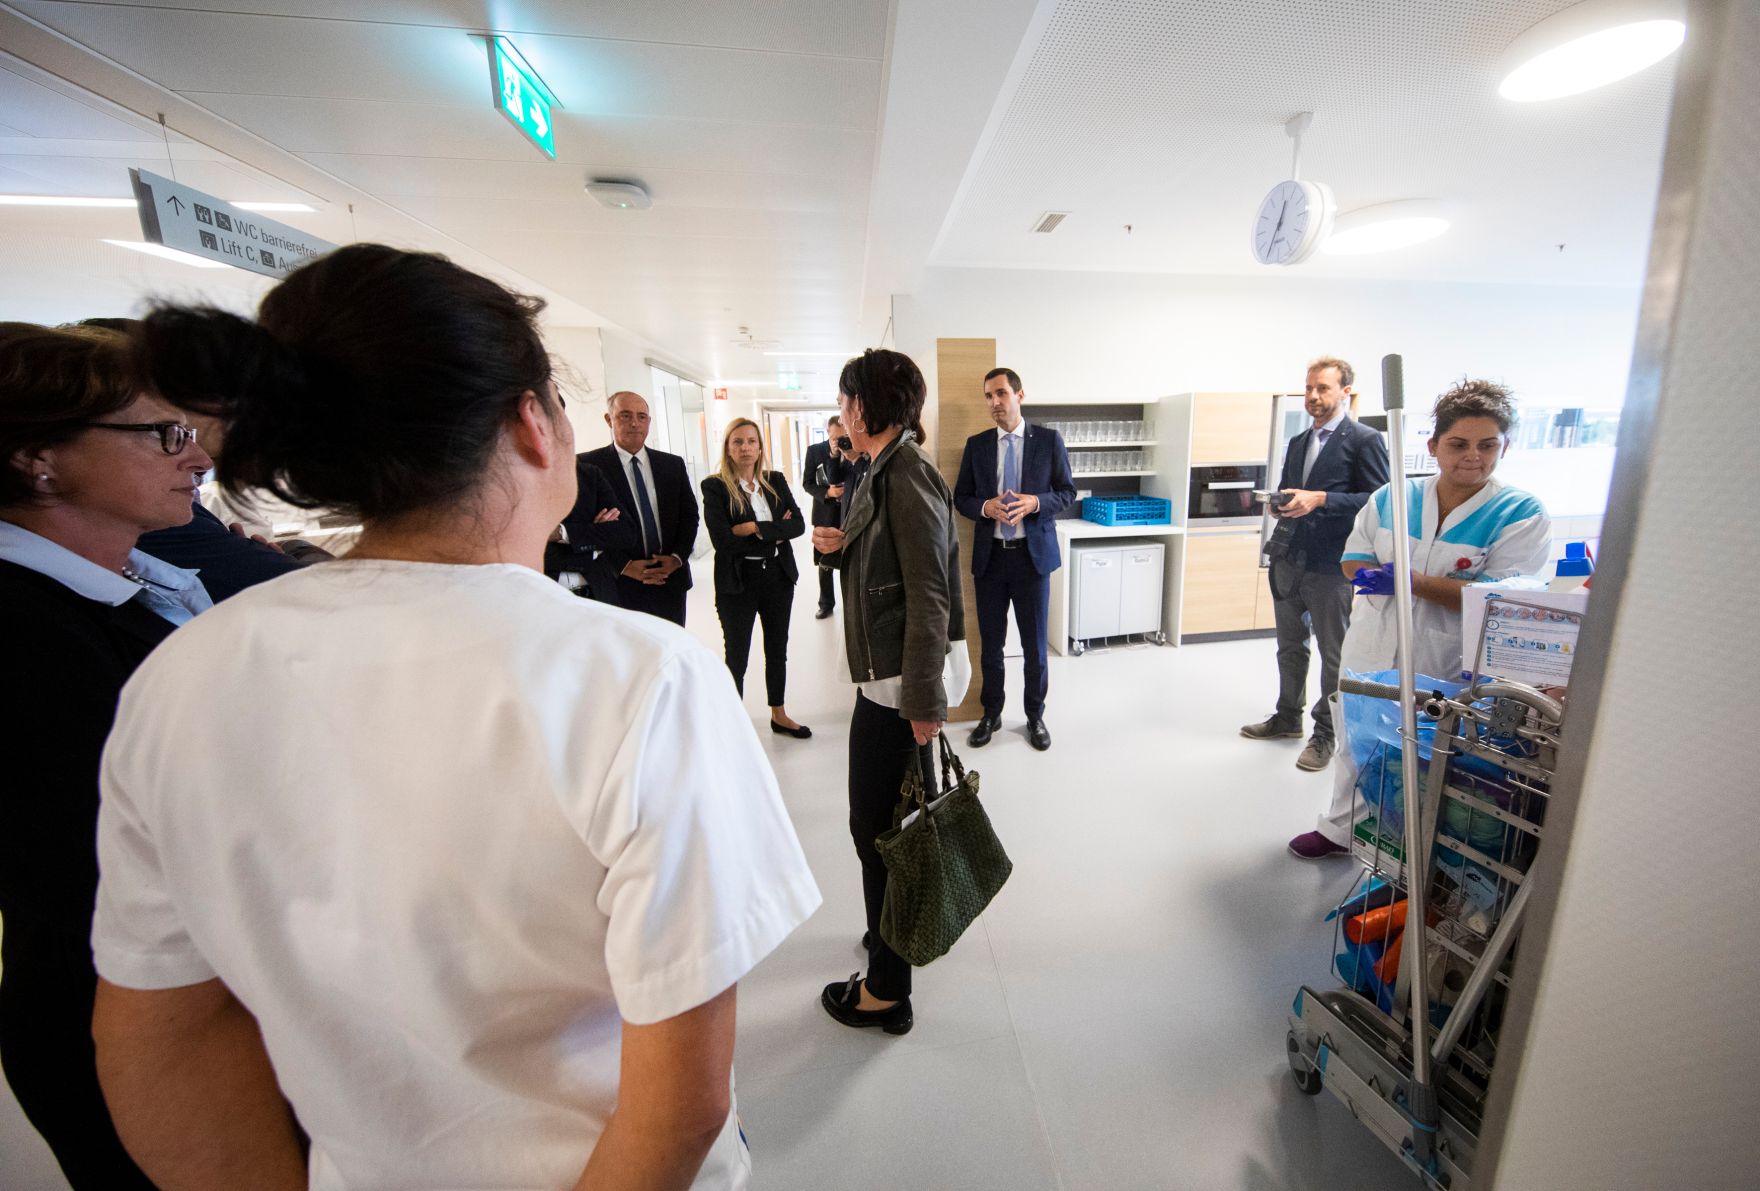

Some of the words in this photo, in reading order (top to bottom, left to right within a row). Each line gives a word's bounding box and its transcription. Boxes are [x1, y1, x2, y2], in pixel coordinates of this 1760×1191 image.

[220, 237, 243, 258] Lift
[233, 219, 257, 239] WC
[260, 228, 318, 258] barrierefrei
